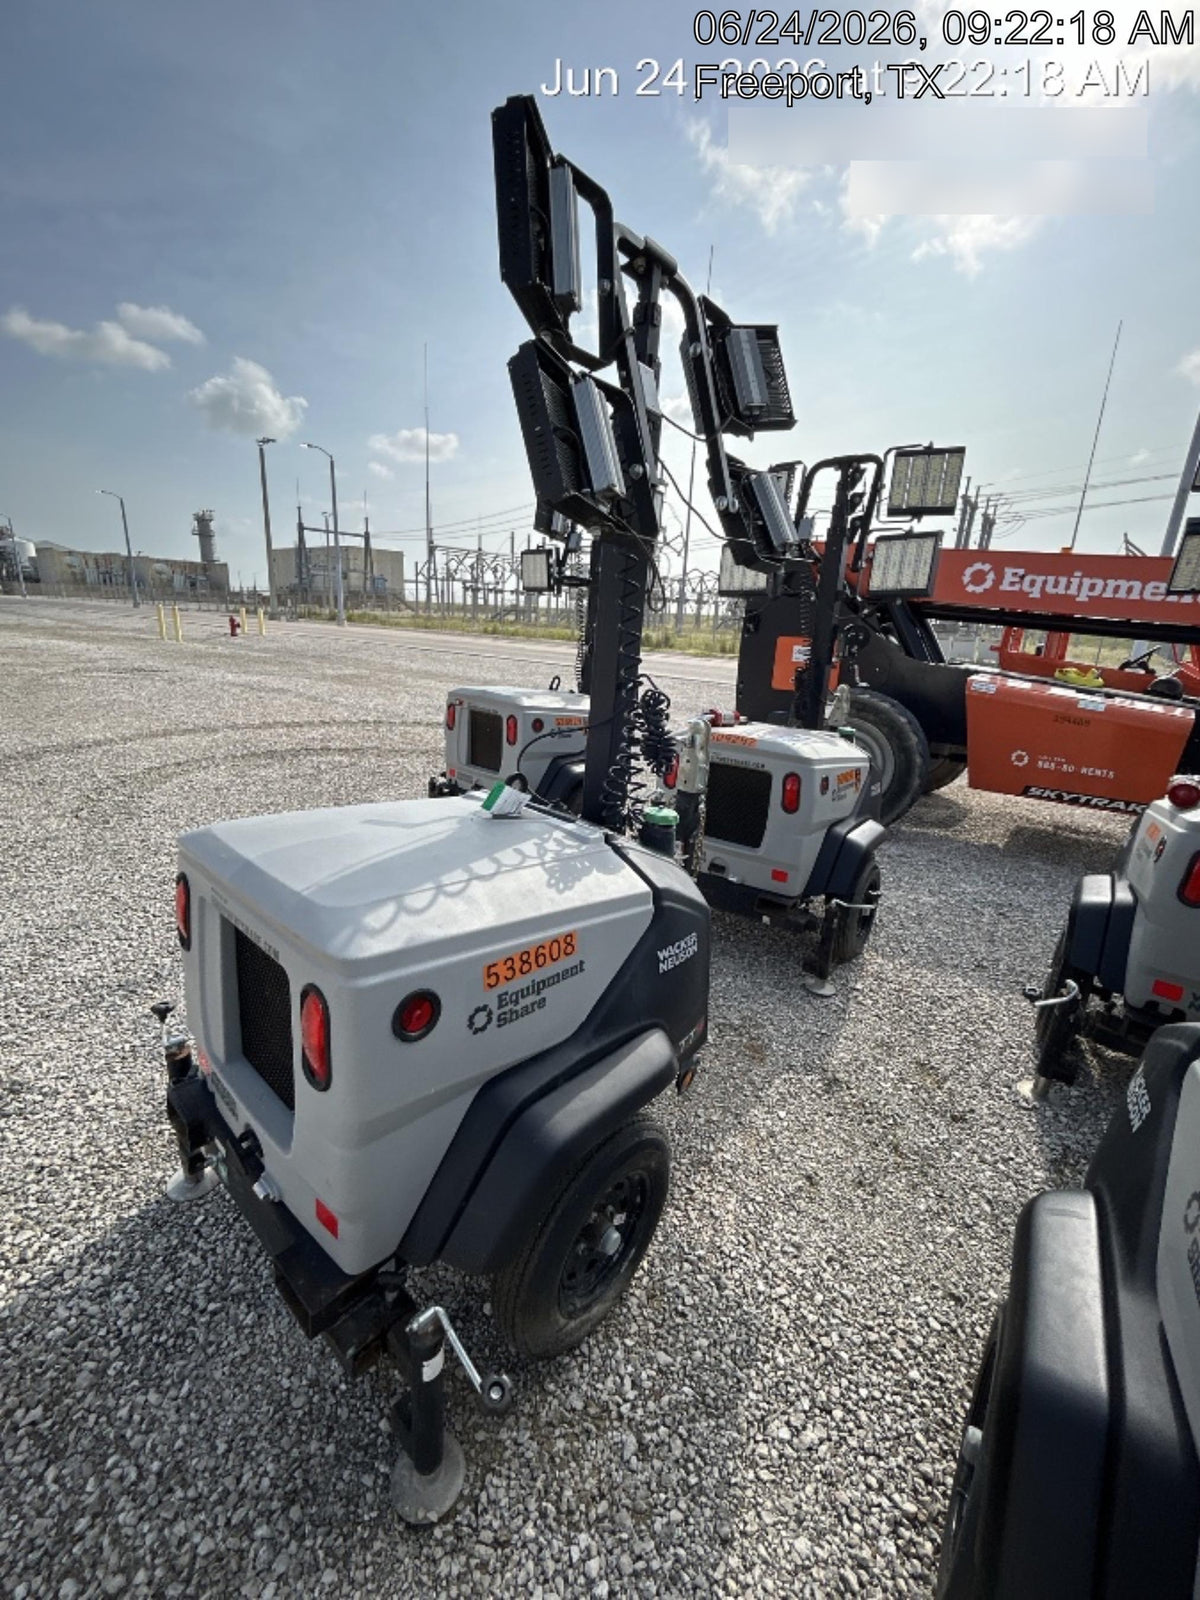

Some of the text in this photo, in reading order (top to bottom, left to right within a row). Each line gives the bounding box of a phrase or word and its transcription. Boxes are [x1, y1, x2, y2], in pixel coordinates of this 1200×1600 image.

[999, 567, 1200, 603] Equipme
[1027, 786, 1148, 813] SKYTRAK
[486, 933, 577, 990] 538608
[657, 932, 698, 961] WACKER
[659, 942, 698, 974] NEUSON
[497, 960, 586, 1010] Equipment
[496, 997, 547, 1029] Share
